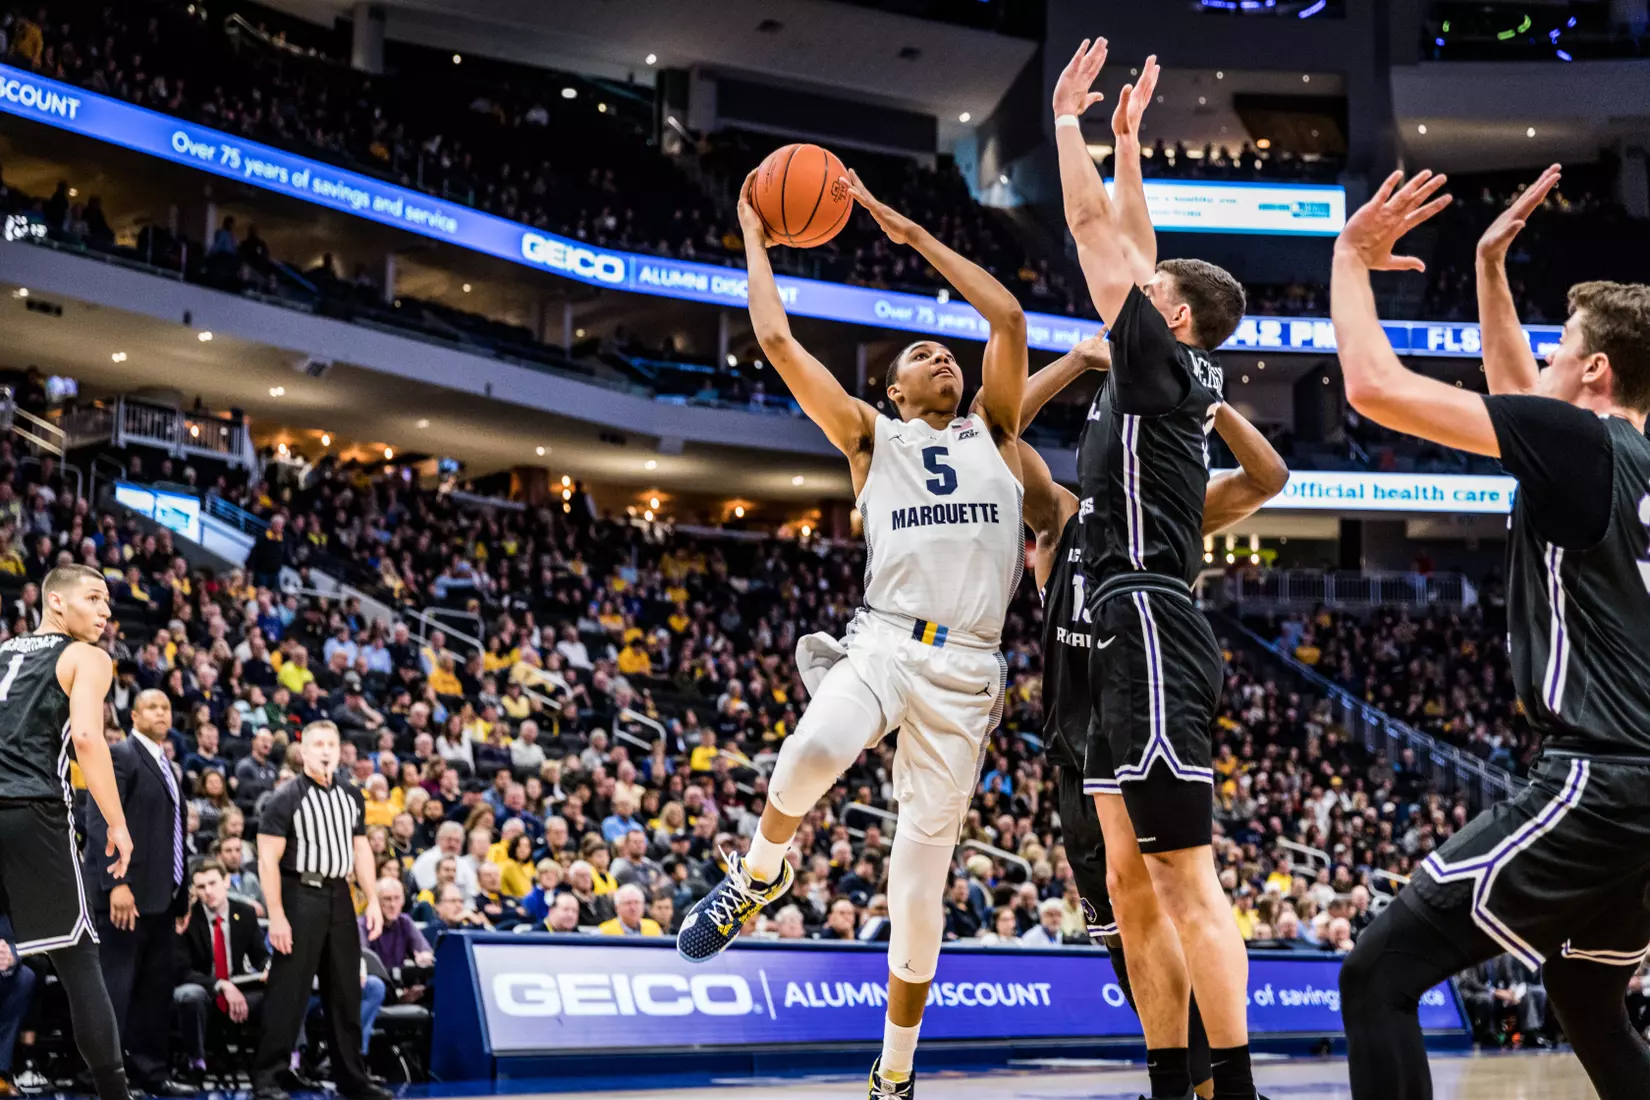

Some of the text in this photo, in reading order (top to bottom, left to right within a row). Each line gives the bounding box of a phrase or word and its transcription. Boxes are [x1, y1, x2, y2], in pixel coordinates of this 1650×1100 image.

[172, 131, 458, 234] Over 75 years of savings and service
[521, 232, 625, 284] GEICO
[639, 266, 708, 290] ALUMNI
[874, 299, 912, 321] Over
[916, 304, 935, 326] 75
[937, 312, 976, 331] years
[922, 446, 958, 496] 5
[1283, 482, 1364, 500] Official
[1373, 484, 1445, 502] health
[1453, 490, 1500, 503] care
[892, 503, 1000, 531] MARQUETTE
[0, 653, 24, 701] 1
[493, 973, 754, 1016] GEICO
[785, 981, 889, 1008] ALUMN
[1253, 983, 1340, 1012] of saving
